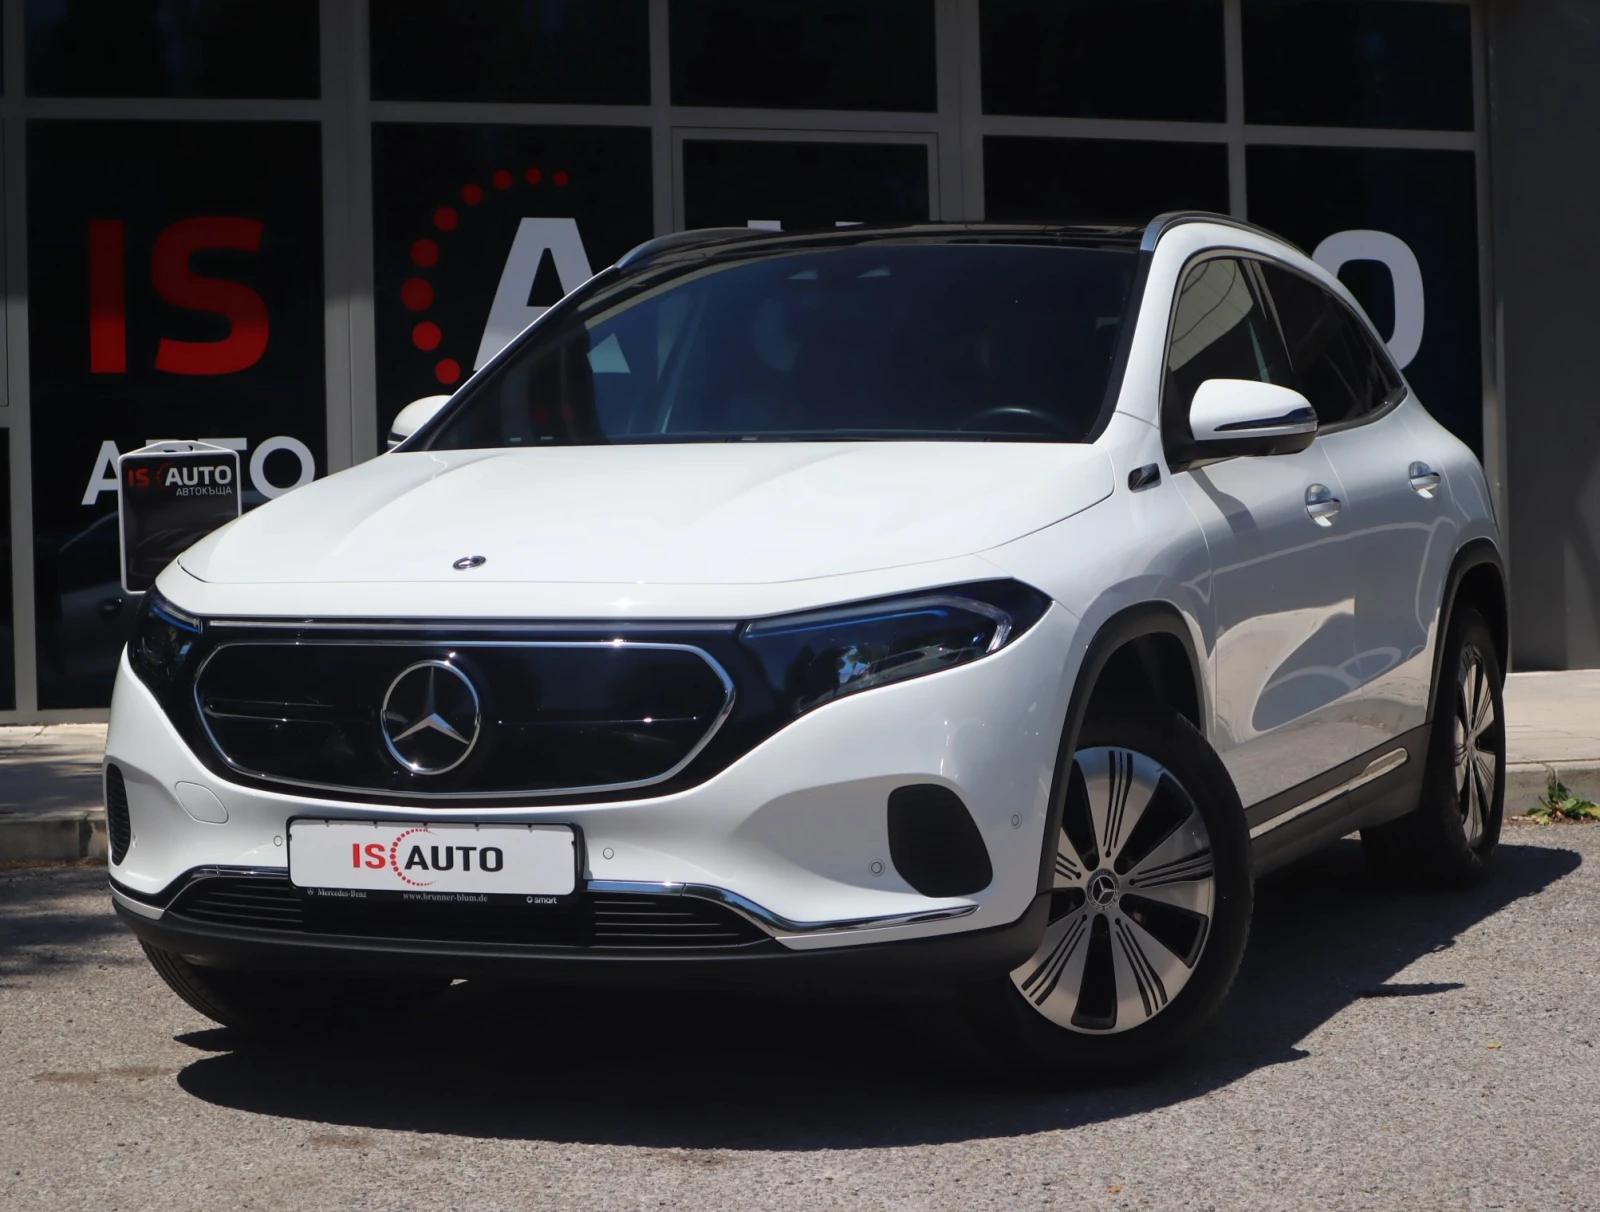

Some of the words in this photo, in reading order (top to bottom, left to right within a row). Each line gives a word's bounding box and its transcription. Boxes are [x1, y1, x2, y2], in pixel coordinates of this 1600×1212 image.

[88, 216, 270, 376] IS
[128, 468, 150, 487] IS
[165, 465, 232, 486] AUTO
[176, 486, 233, 496] АВТОКЪЩА
[352, 843, 386, 868] IS
[404, 845, 503, 872] AUTO
[317, 889, 367, 898] Mercedes-Benz
[403, 893, 488, 902] www.brunner-blum.de
[534, 896, 557, 905] smart
